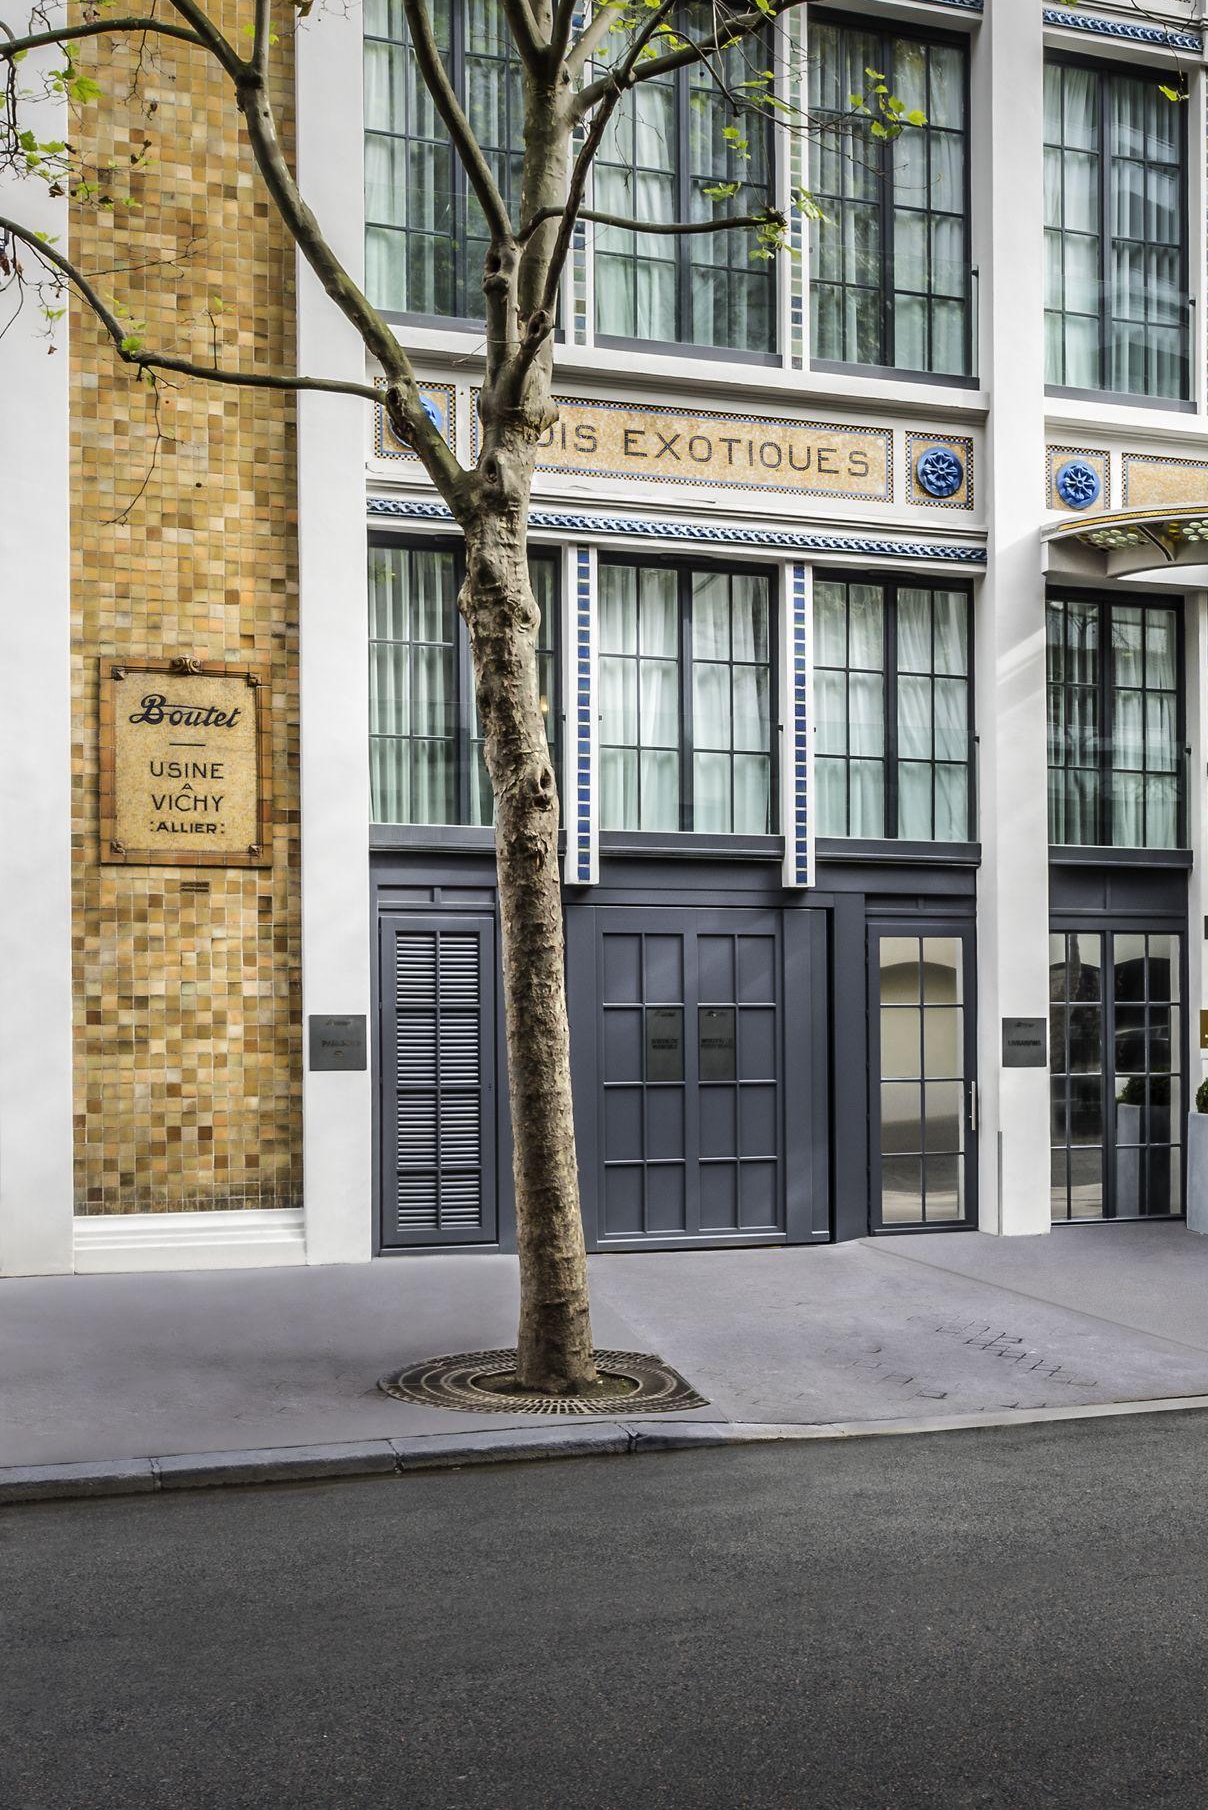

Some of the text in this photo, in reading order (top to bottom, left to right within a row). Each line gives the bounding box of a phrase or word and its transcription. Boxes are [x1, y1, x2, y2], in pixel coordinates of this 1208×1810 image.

[536, 422, 598, 454] OIS
[129, 693, 242, 728] Boutet
[150, 761, 224, 779] USINE
[152, 794, 224, 812] VICHY
